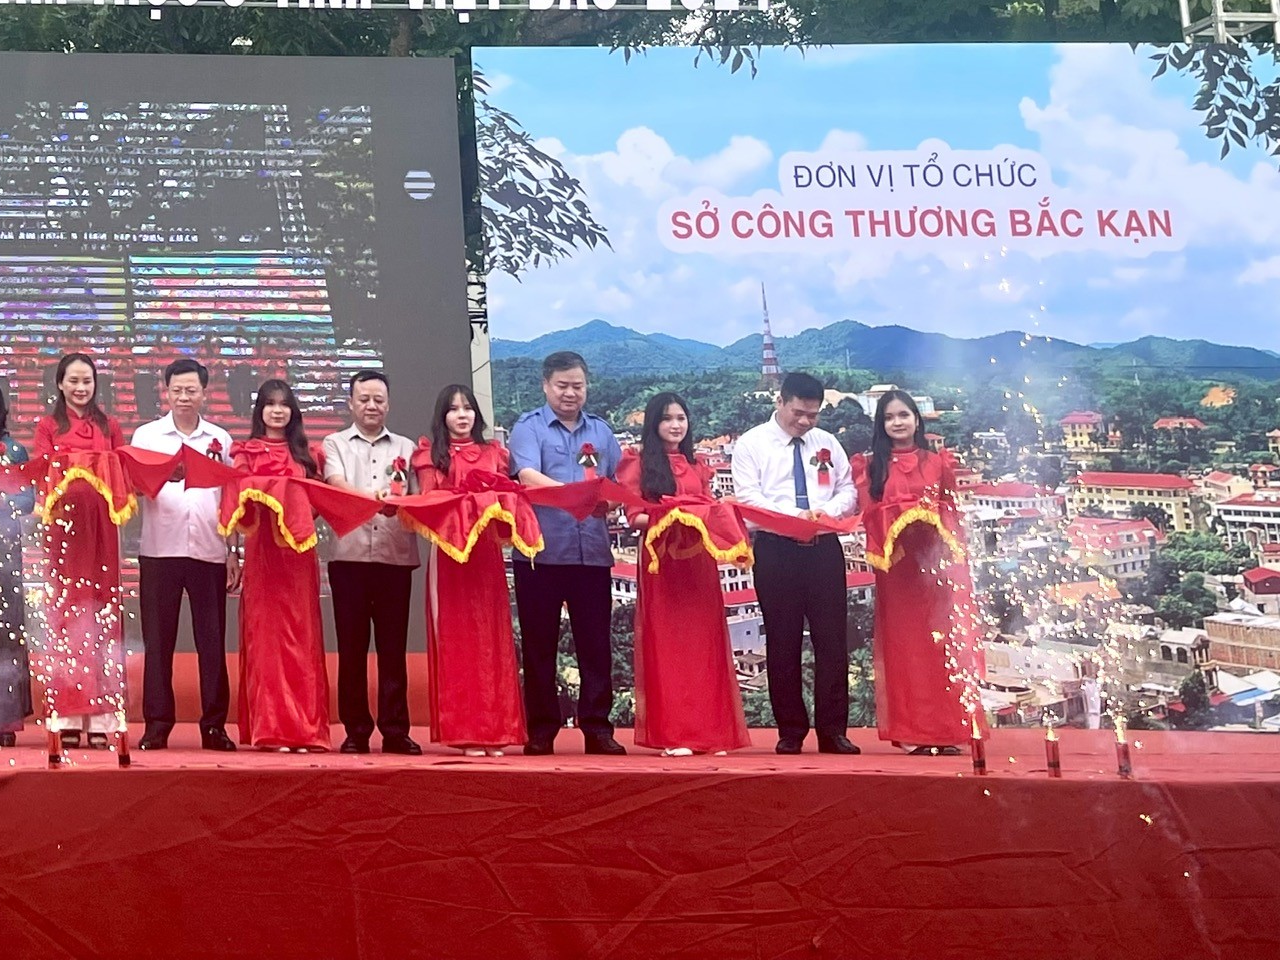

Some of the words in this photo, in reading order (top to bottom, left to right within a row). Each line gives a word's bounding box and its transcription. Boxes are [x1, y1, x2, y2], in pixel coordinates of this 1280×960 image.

[793, 163, 856, 189] ĐƠN
[866, 164, 894, 192] VỊ
[902, 152, 944, 188] TỔ
[952, 160, 1037, 188] CHỨC
[671, 200, 721, 239] SỞ
[730, 203, 834, 239] CÔNG
[845, 204, 997, 238] THƯƠNG
[1010, 197, 1084, 238] BẮC
[1097, 208, 1173, 244] KẠN
